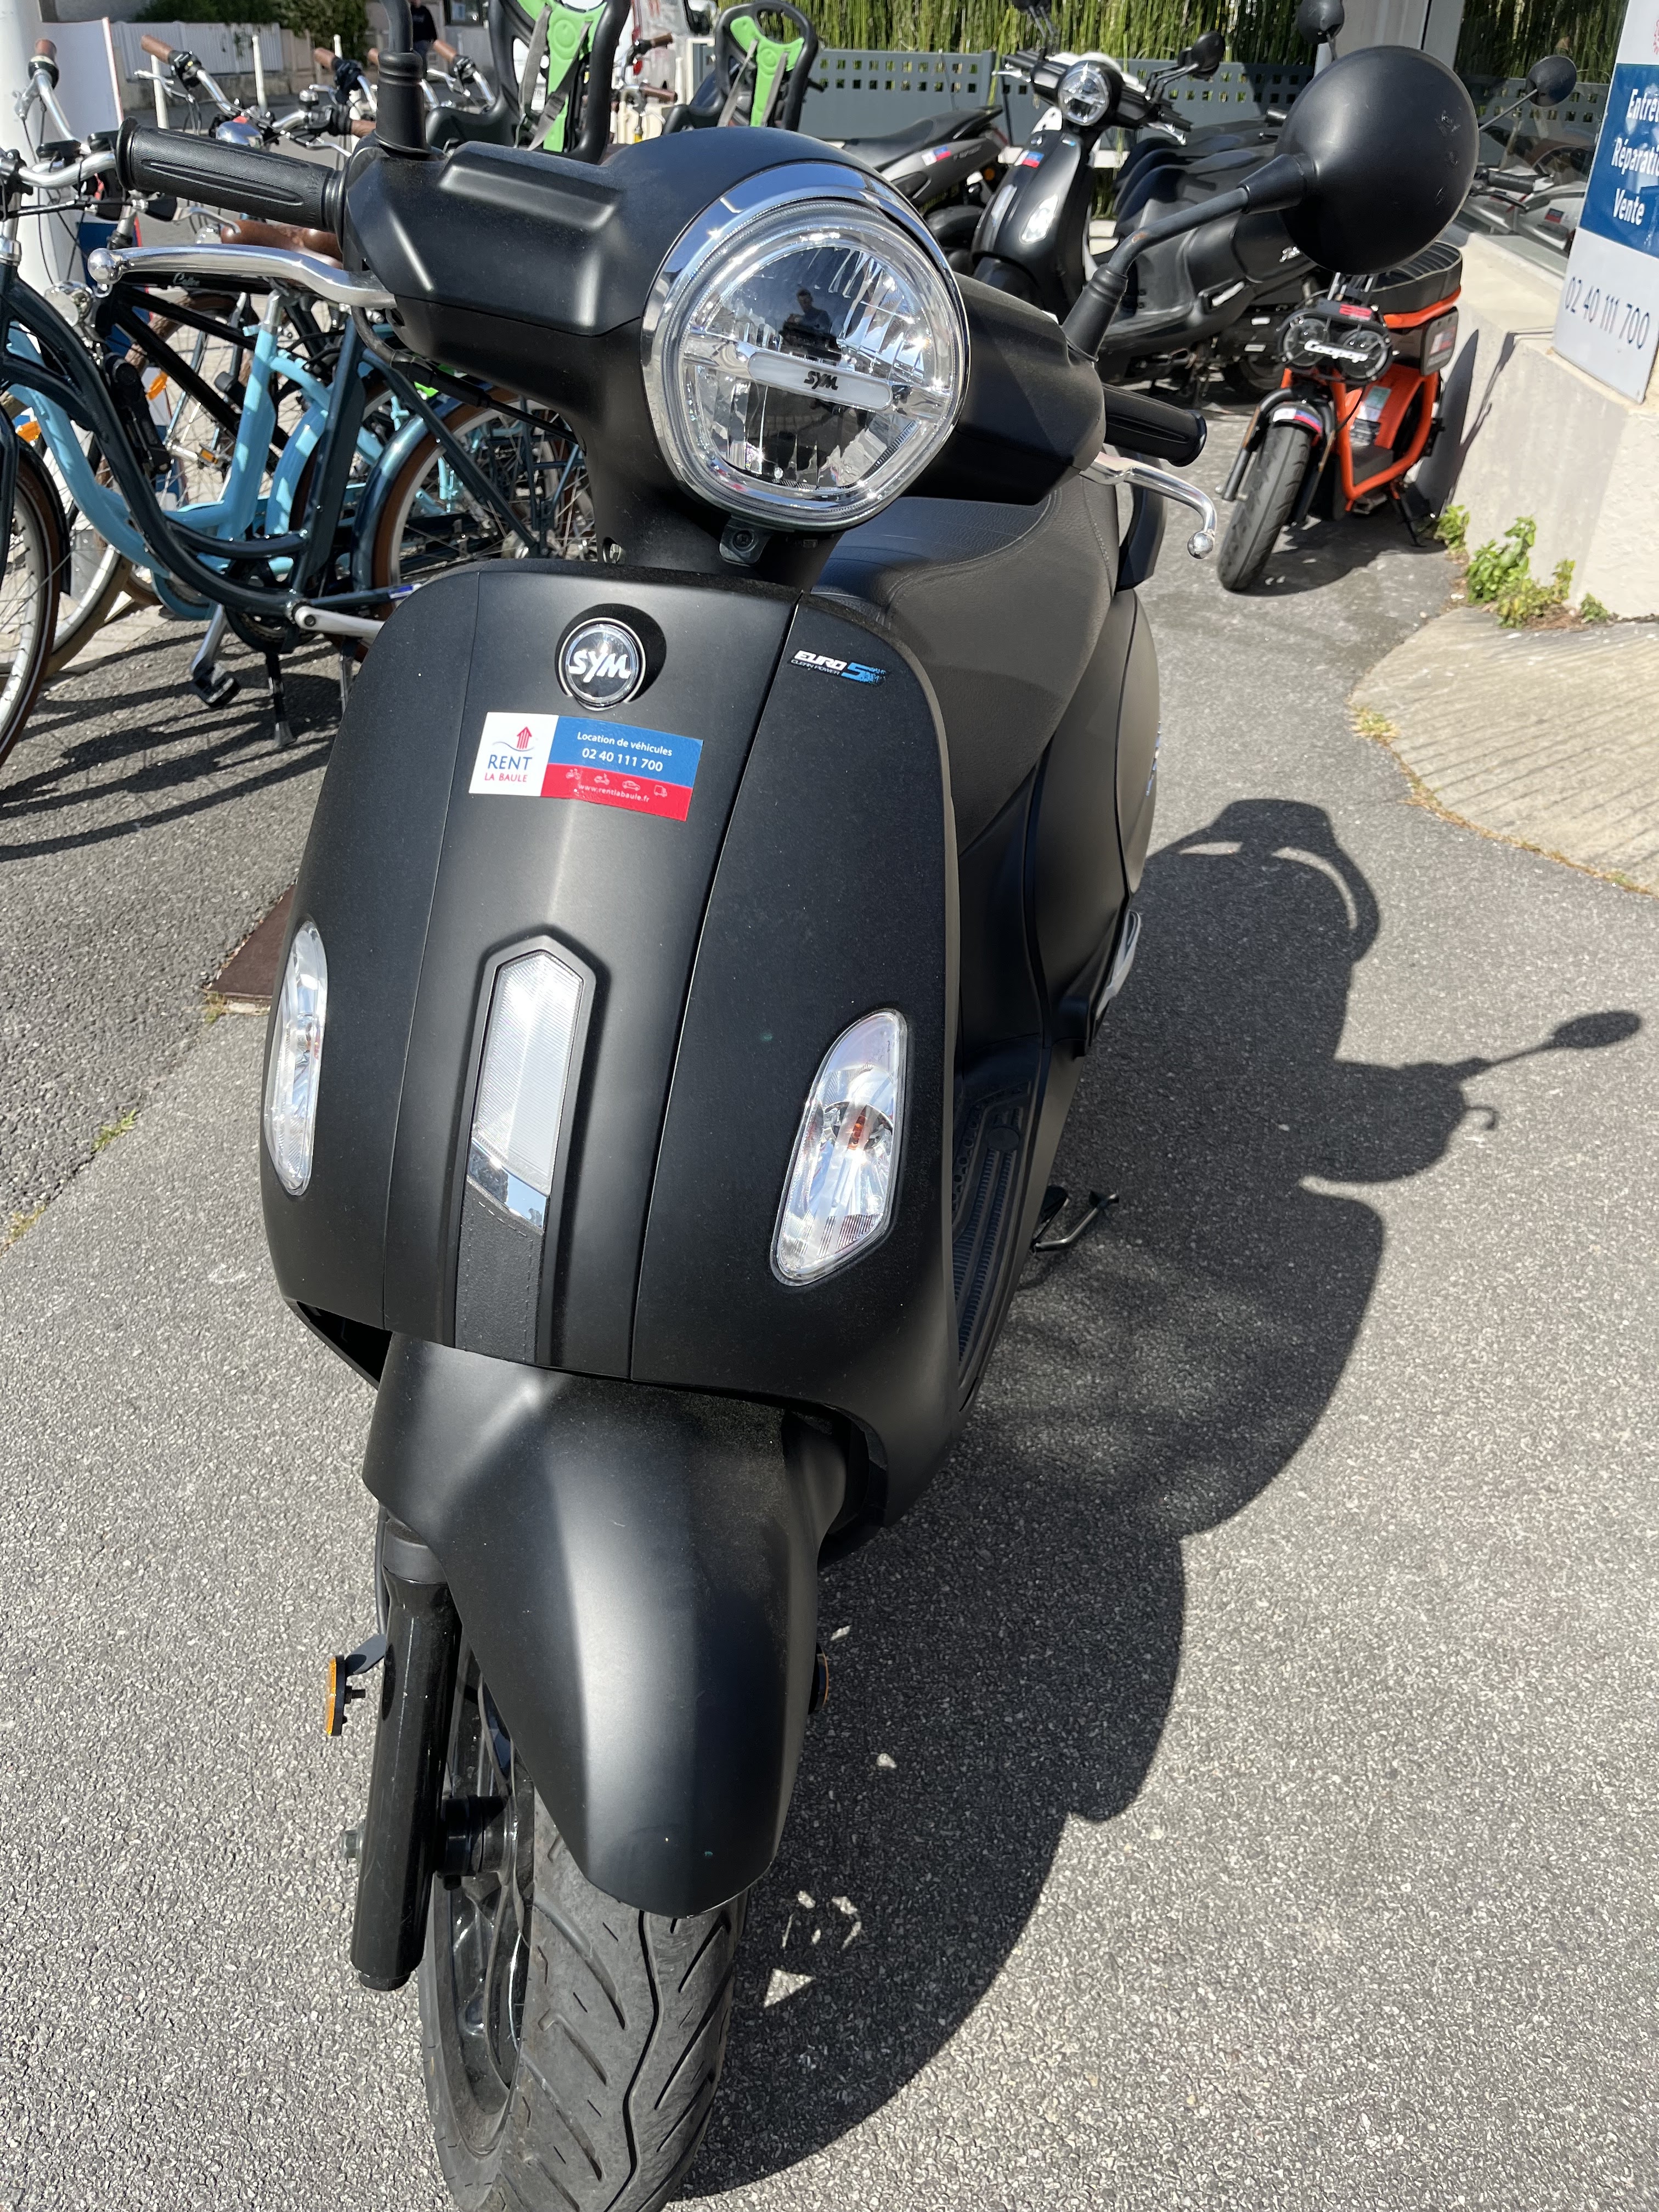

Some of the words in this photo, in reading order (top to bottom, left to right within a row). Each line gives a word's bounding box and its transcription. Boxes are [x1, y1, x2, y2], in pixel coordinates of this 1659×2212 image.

[1613, 188, 1645, 225] Vente
[1565, 276, 1583, 313] 02
[1583, 285, 1601, 324] 40
[1600, 294, 1620, 334] 111
[1618, 303, 1650, 349] 700
[804, 371, 838, 390] SYM
[569, 648, 631, 682] SYM
[791, 659, 814, 669] CLEAN
[814, 665, 840, 675] POWER
[794, 650, 847, 671] EURO
[841, 662, 885, 685] 5
[577, 732, 615, 745] Location
[617, 738, 629, 747] de
[631, 742, 673, 757] véhicules
[488, 754, 533, 770] RENT
[582, 748, 597, 759] 02
[599, 751, 614, 762] 40
[618, 754, 637, 767] 111
[641, 758, 663, 772] 700
[484, 772, 494, 781] LA
[499, 772, 528, 782] BAULE
[578, 783, 650, 803] www.rentlabaule.fr
